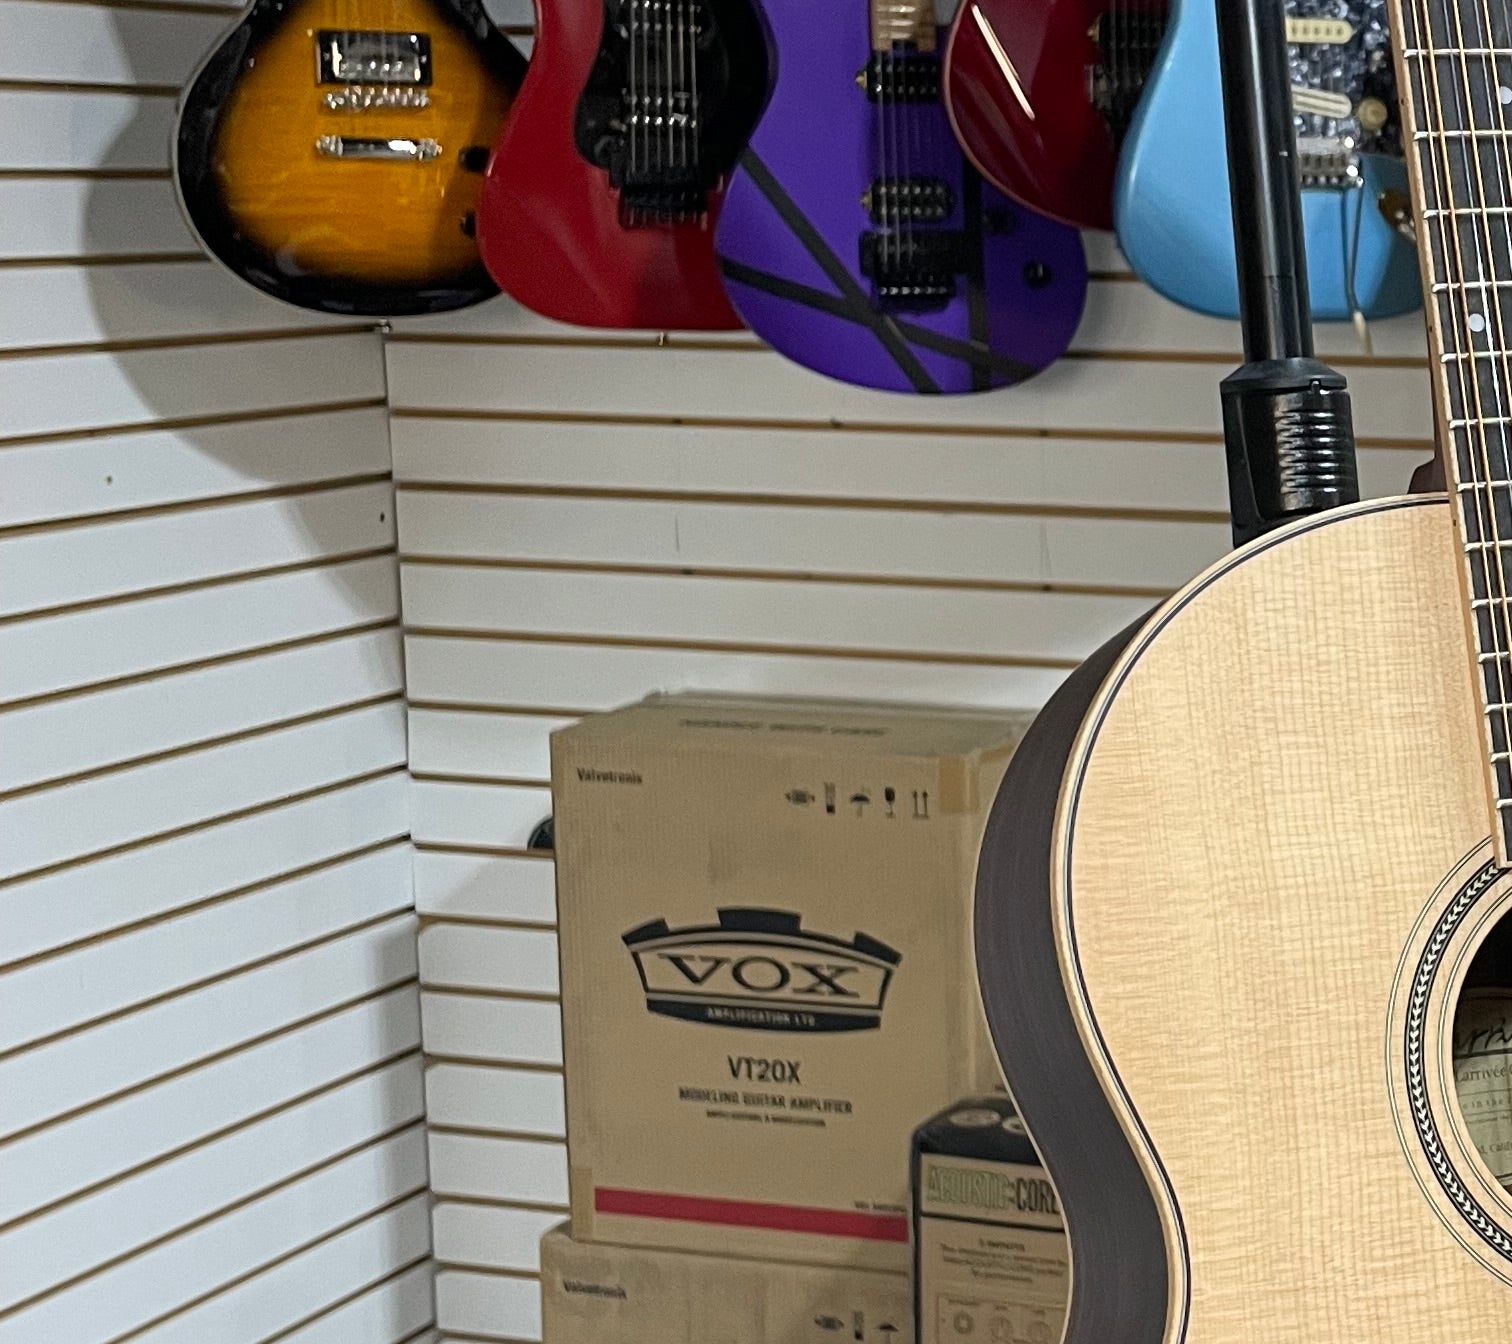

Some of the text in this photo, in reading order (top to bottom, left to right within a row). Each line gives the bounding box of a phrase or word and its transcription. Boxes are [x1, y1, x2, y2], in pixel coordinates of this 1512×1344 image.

[657, 953, 860, 999] VOX
[727, 1055, 802, 1084] VT20X
[742, 1090, 786, 1109] GUITAR
[789, 1094, 853, 1114] AMPLIFIER
